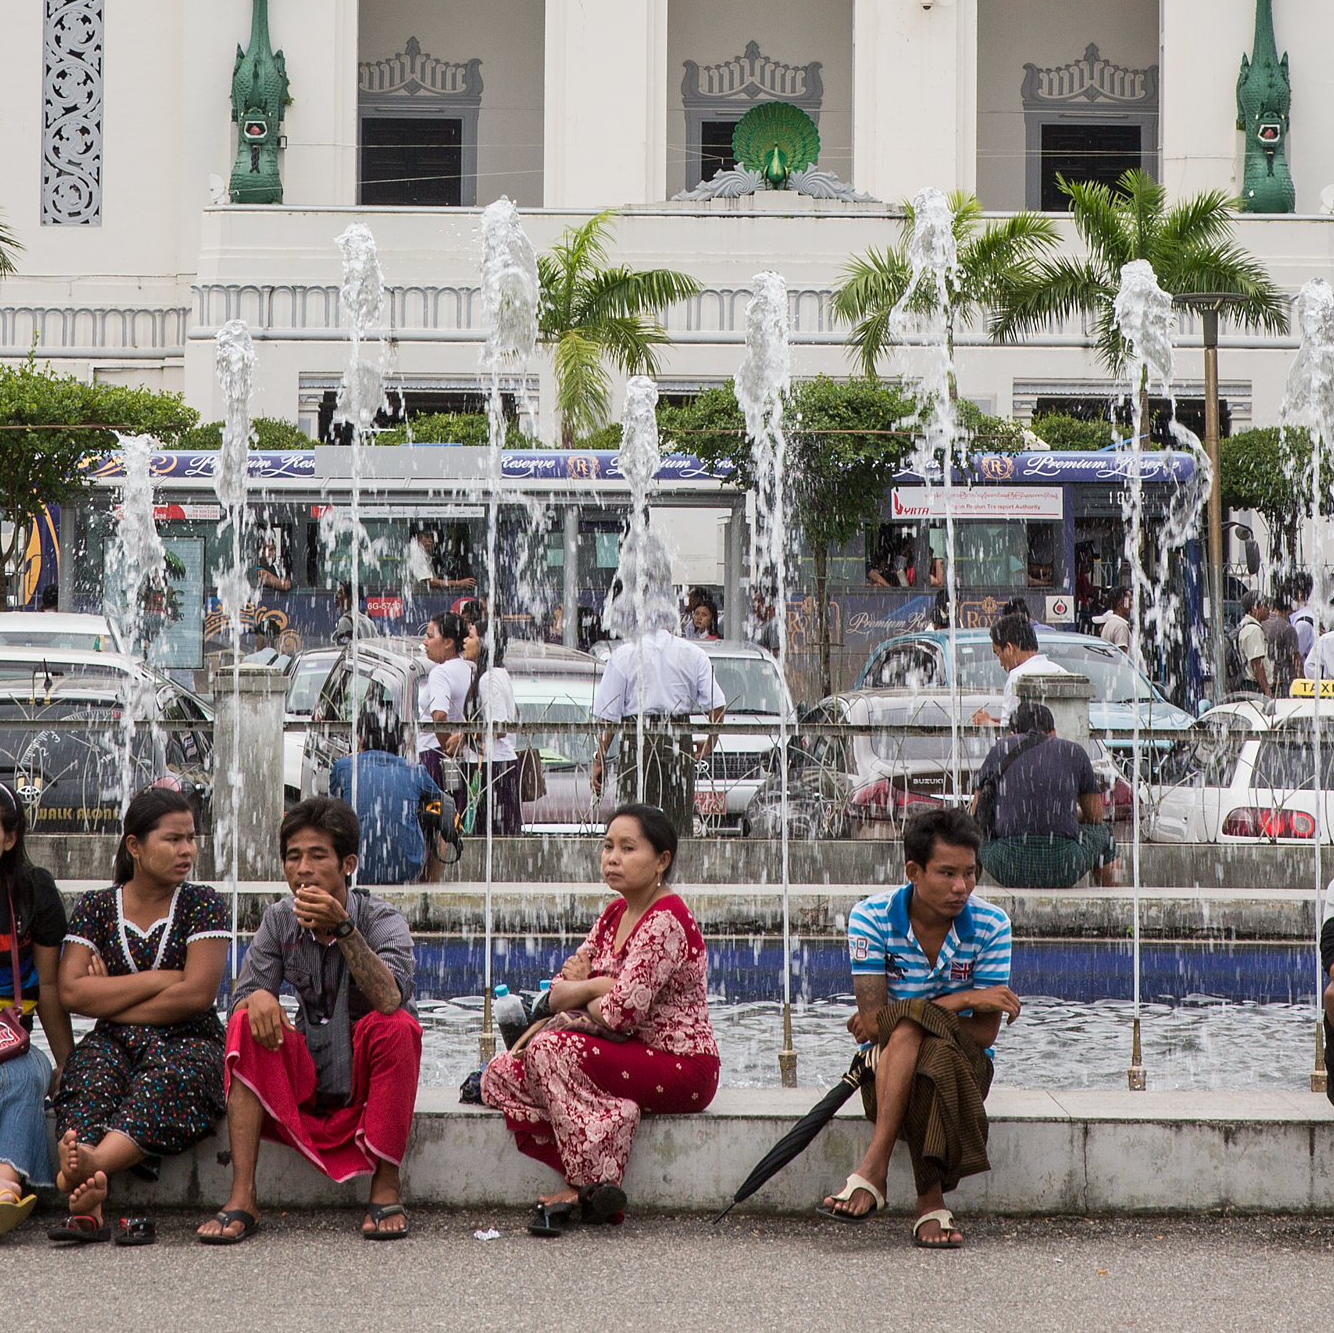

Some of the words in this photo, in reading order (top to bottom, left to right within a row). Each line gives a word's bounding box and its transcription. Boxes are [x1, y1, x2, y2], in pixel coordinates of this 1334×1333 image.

[1023, 456, 1107, 475] Premium
[37, 807, 71, 820] WALK
[77, 807, 121, 820] ALONE
